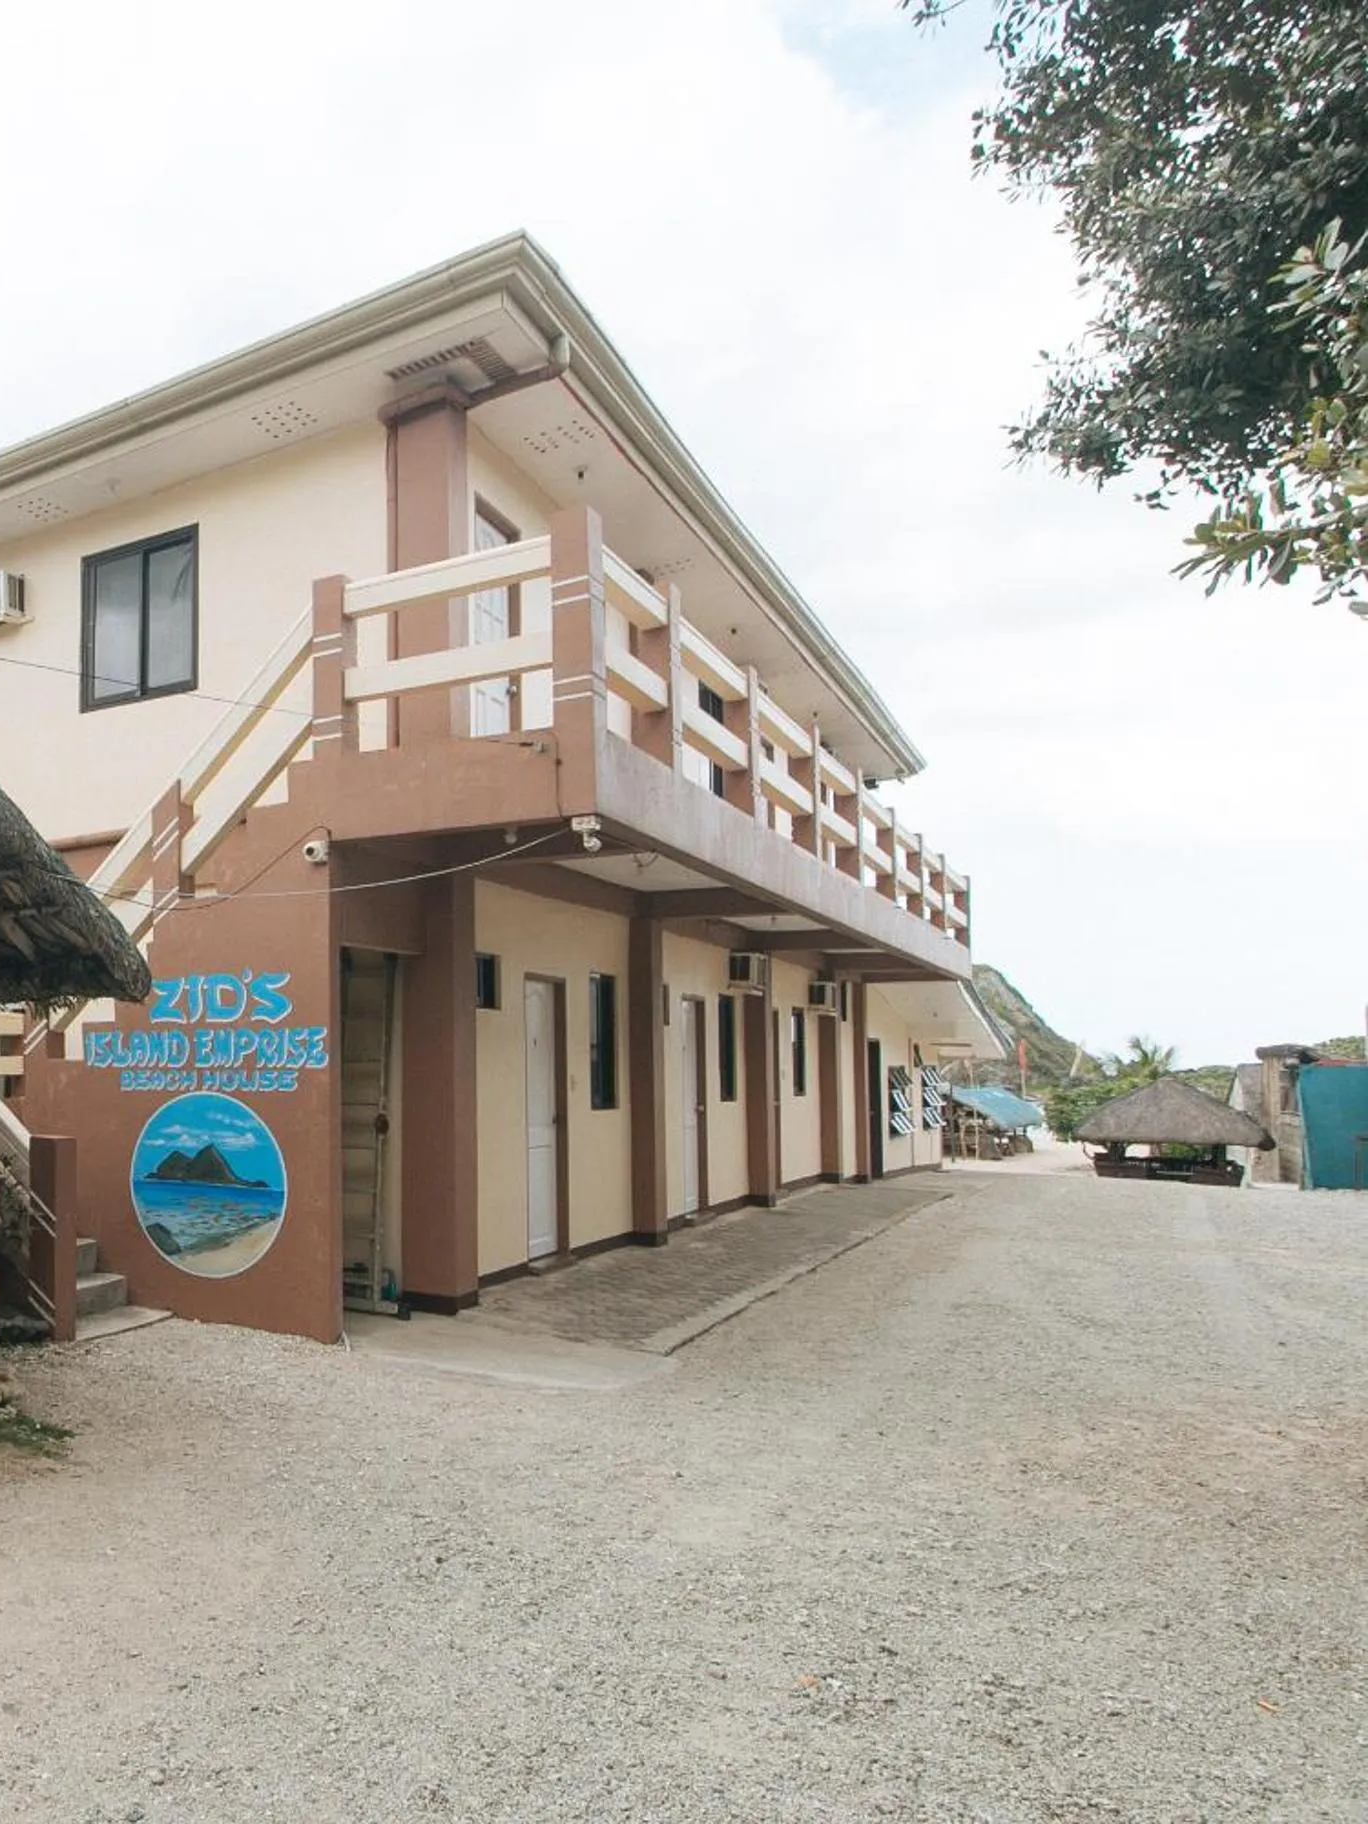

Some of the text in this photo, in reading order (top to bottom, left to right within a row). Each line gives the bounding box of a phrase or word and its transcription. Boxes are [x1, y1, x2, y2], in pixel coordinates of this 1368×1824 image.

[149, 968, 294, 1025] ZID'S
[84, 1026, 329, 1069] ISLAND EMPRISE
[119, 1069, 300, 1092] BEACH HOUSE
